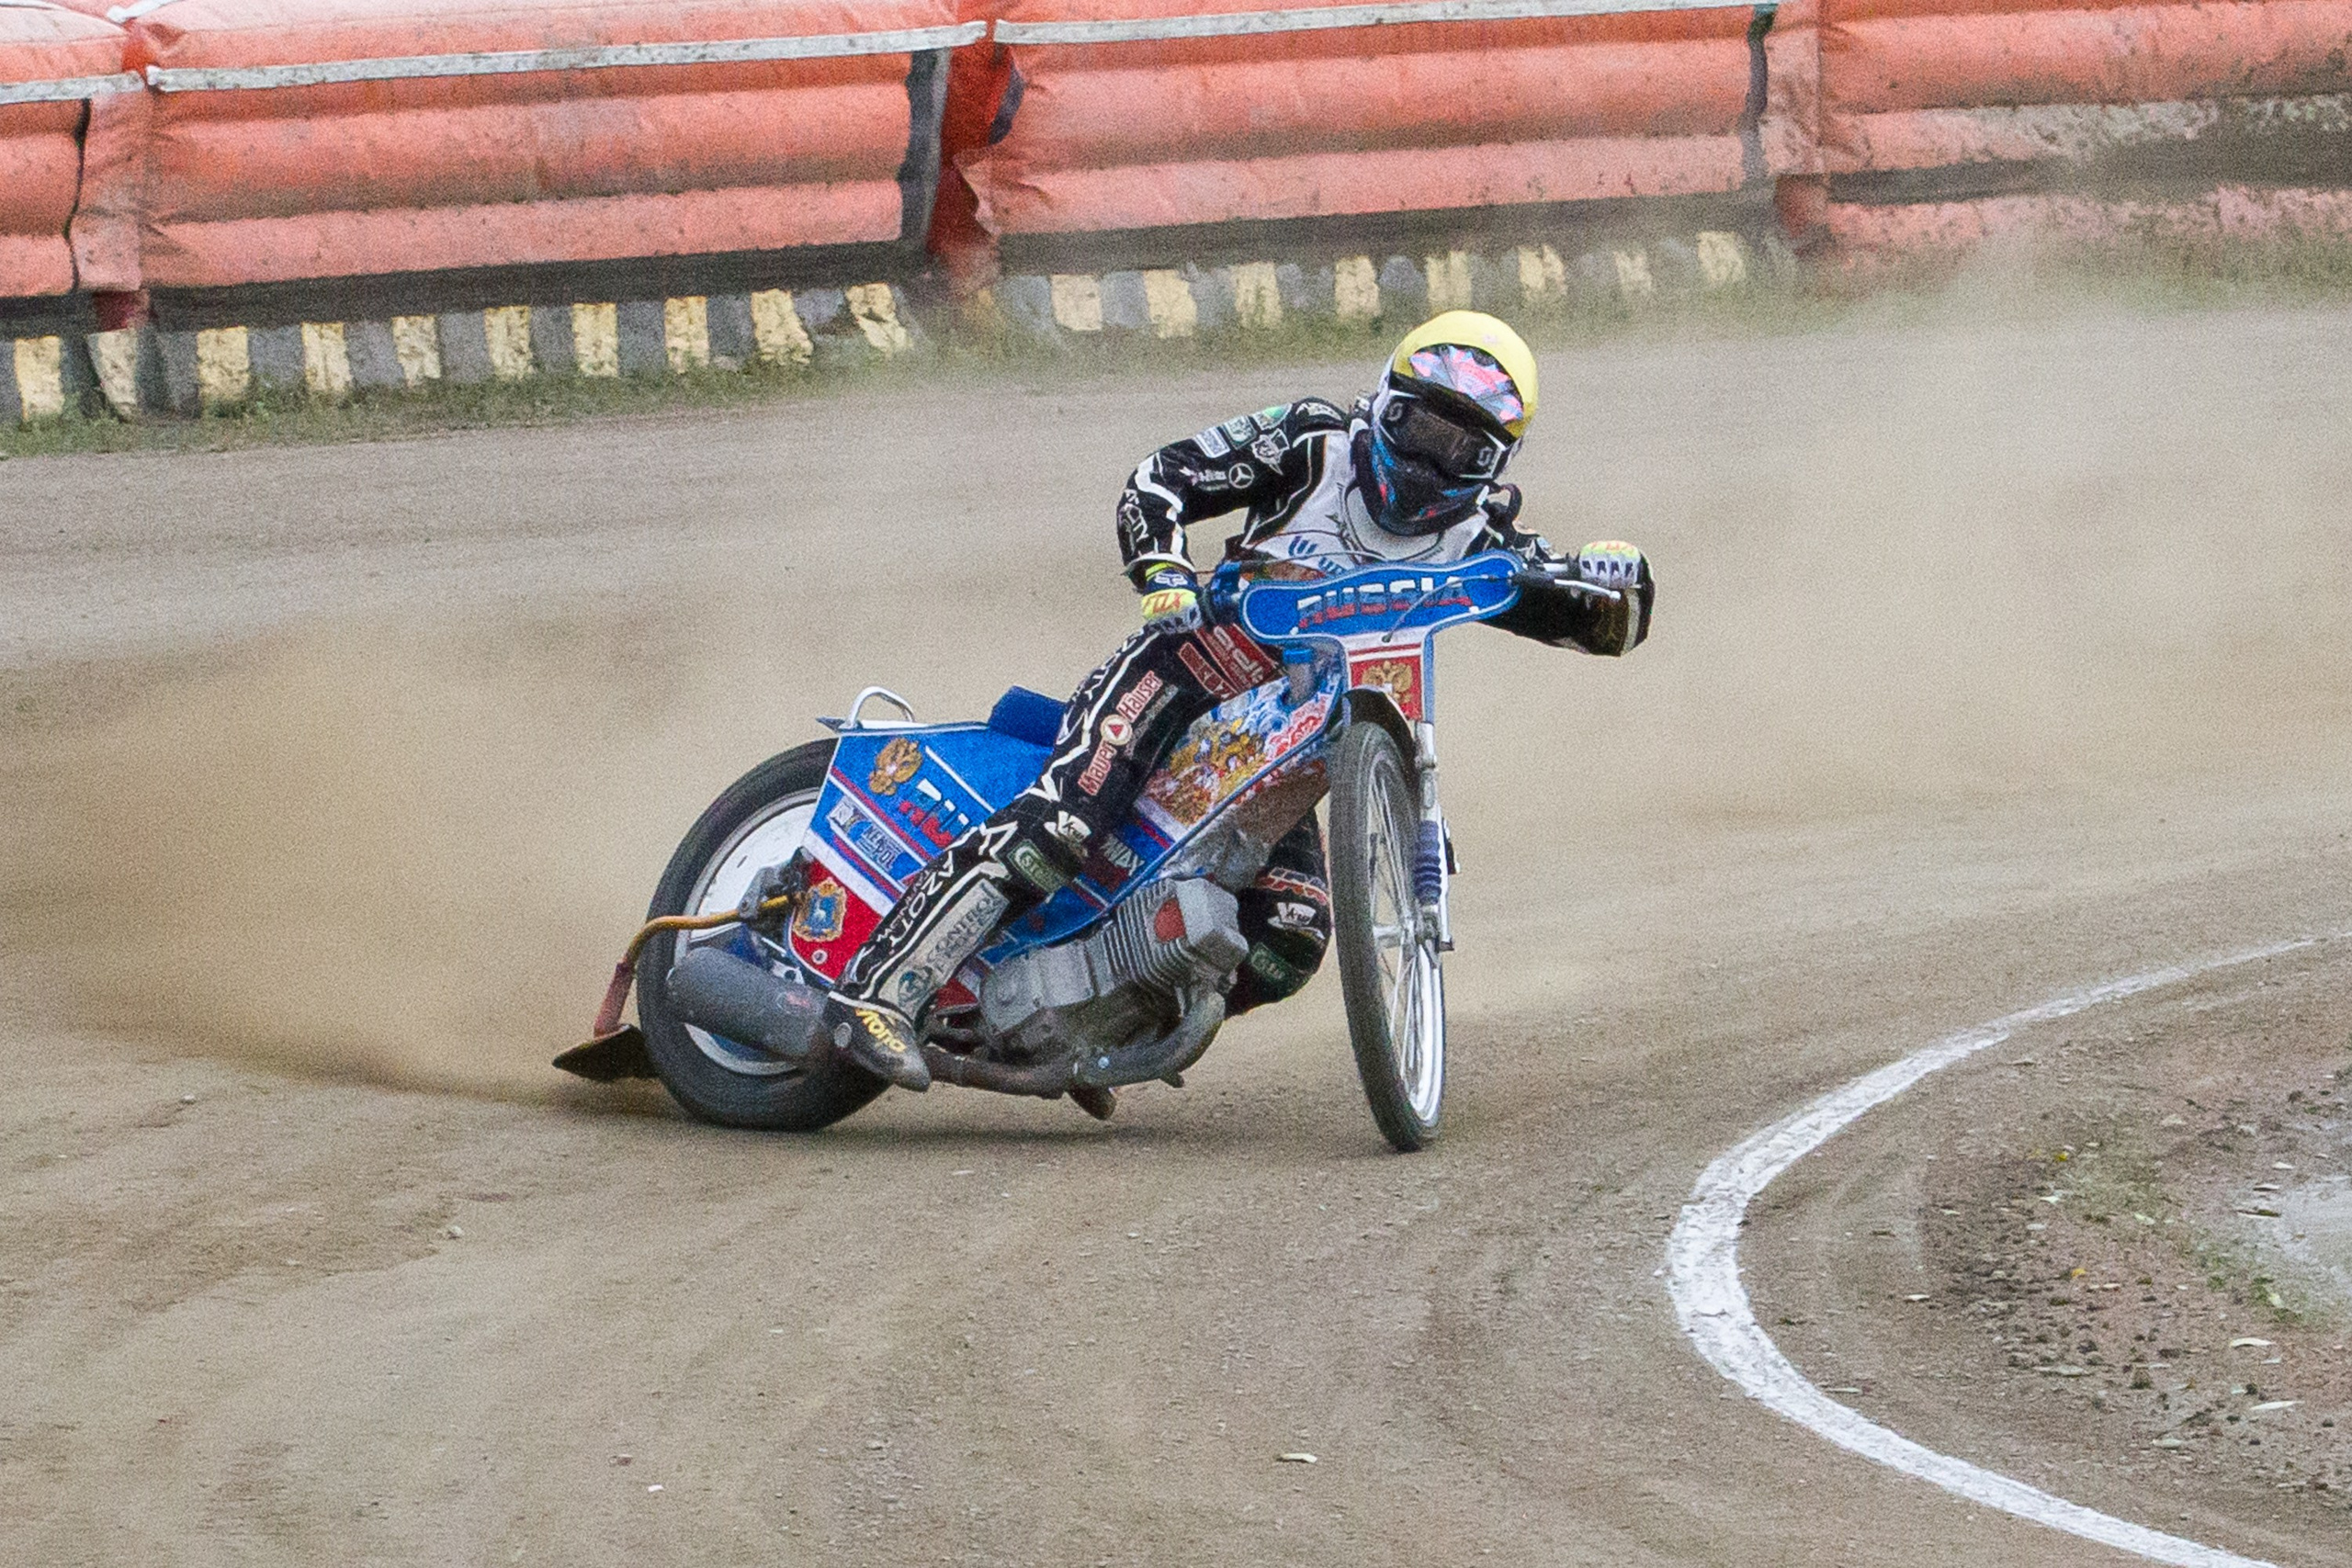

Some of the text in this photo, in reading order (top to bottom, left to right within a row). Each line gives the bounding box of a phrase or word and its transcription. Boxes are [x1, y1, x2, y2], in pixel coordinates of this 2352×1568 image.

[1297, 576, 1473, 628] RUSSIA
[1078, 740, 1117, 795] Mauer
[888, 850, 955, 948] AZOTY
